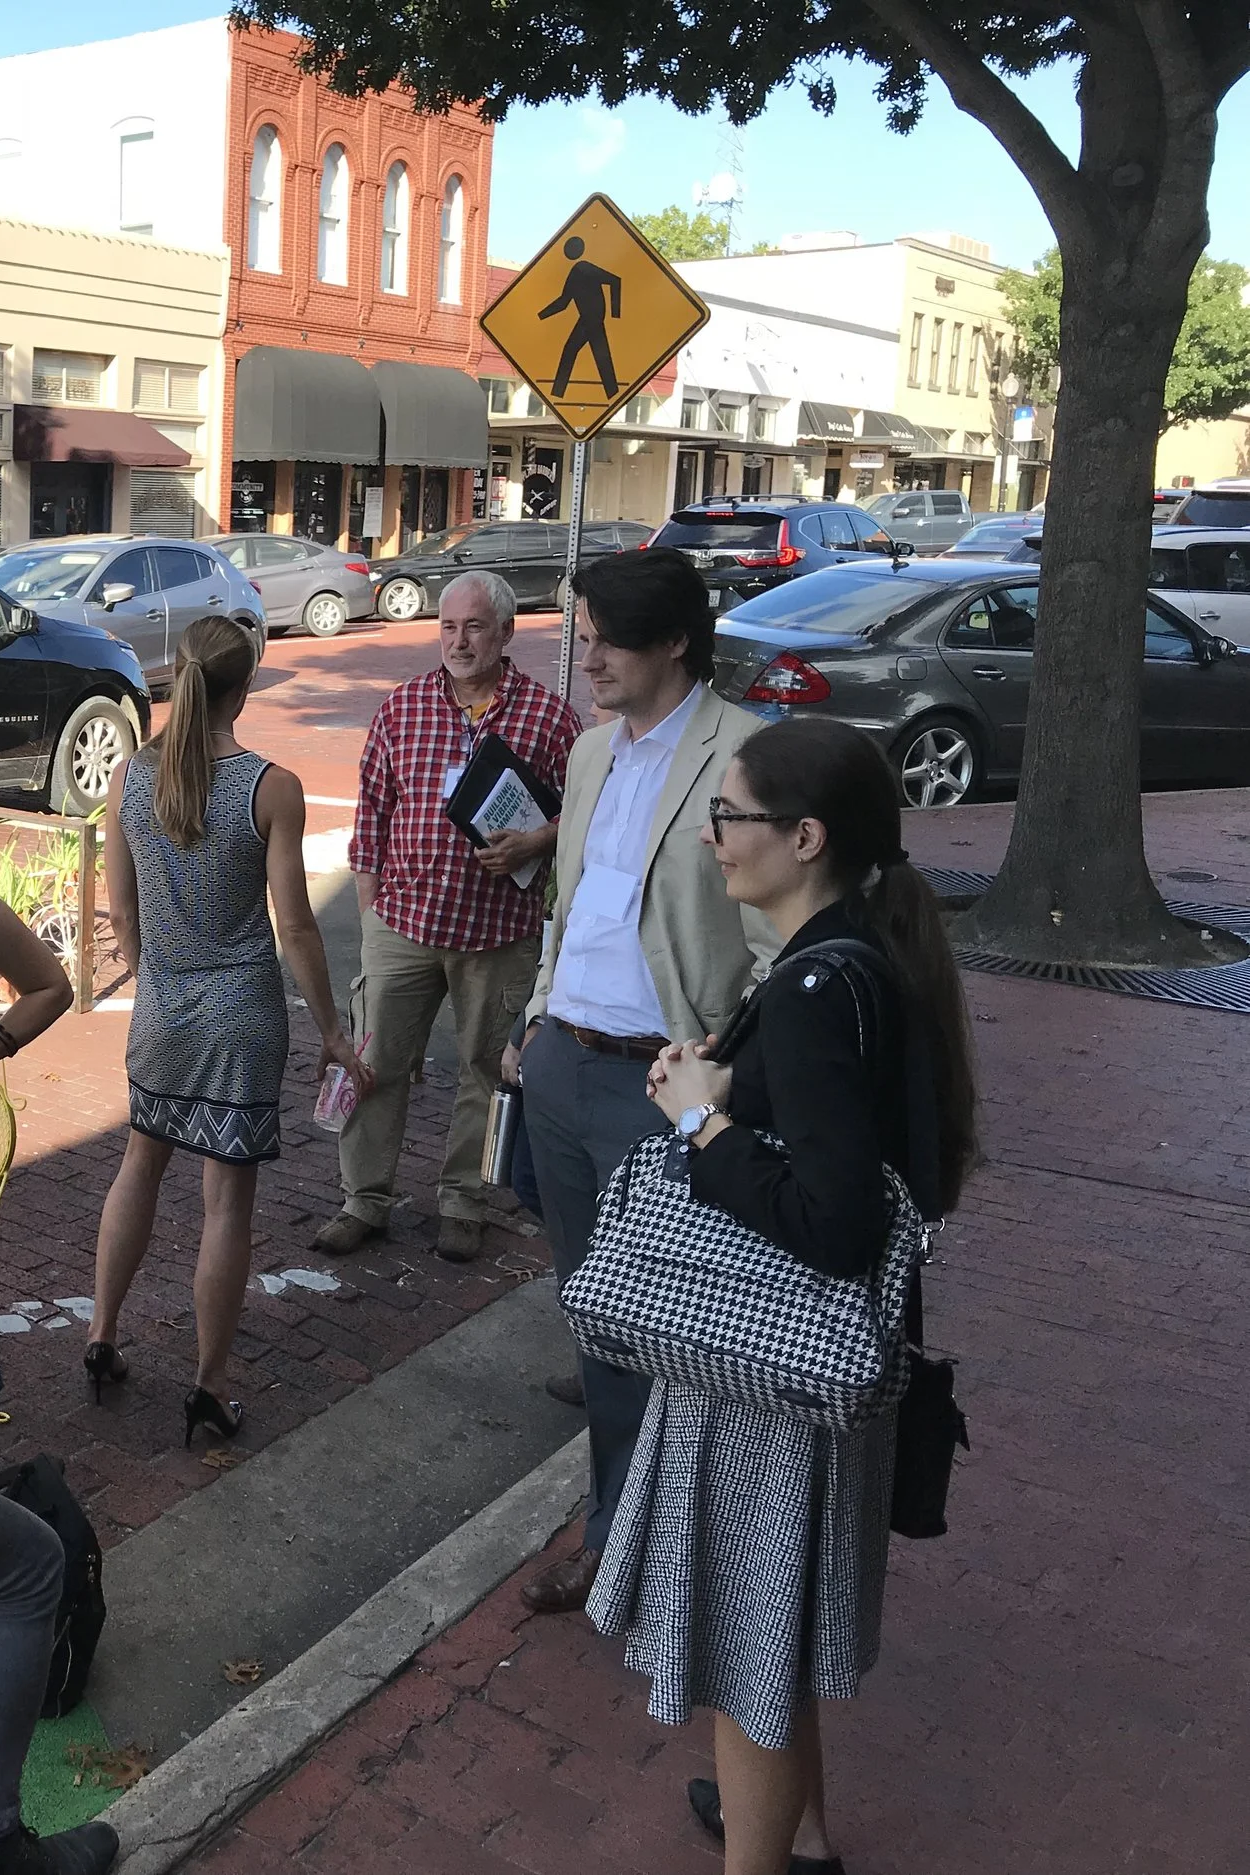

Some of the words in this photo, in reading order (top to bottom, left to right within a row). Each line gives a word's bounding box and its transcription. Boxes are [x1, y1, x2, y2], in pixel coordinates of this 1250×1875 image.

[483, 781, 512, 822] BUILDING
[487, 822, 495, 832] A
[492, 785, 519, 823] VIBRANT
[495, 789, 525, 831] MMUNITY
